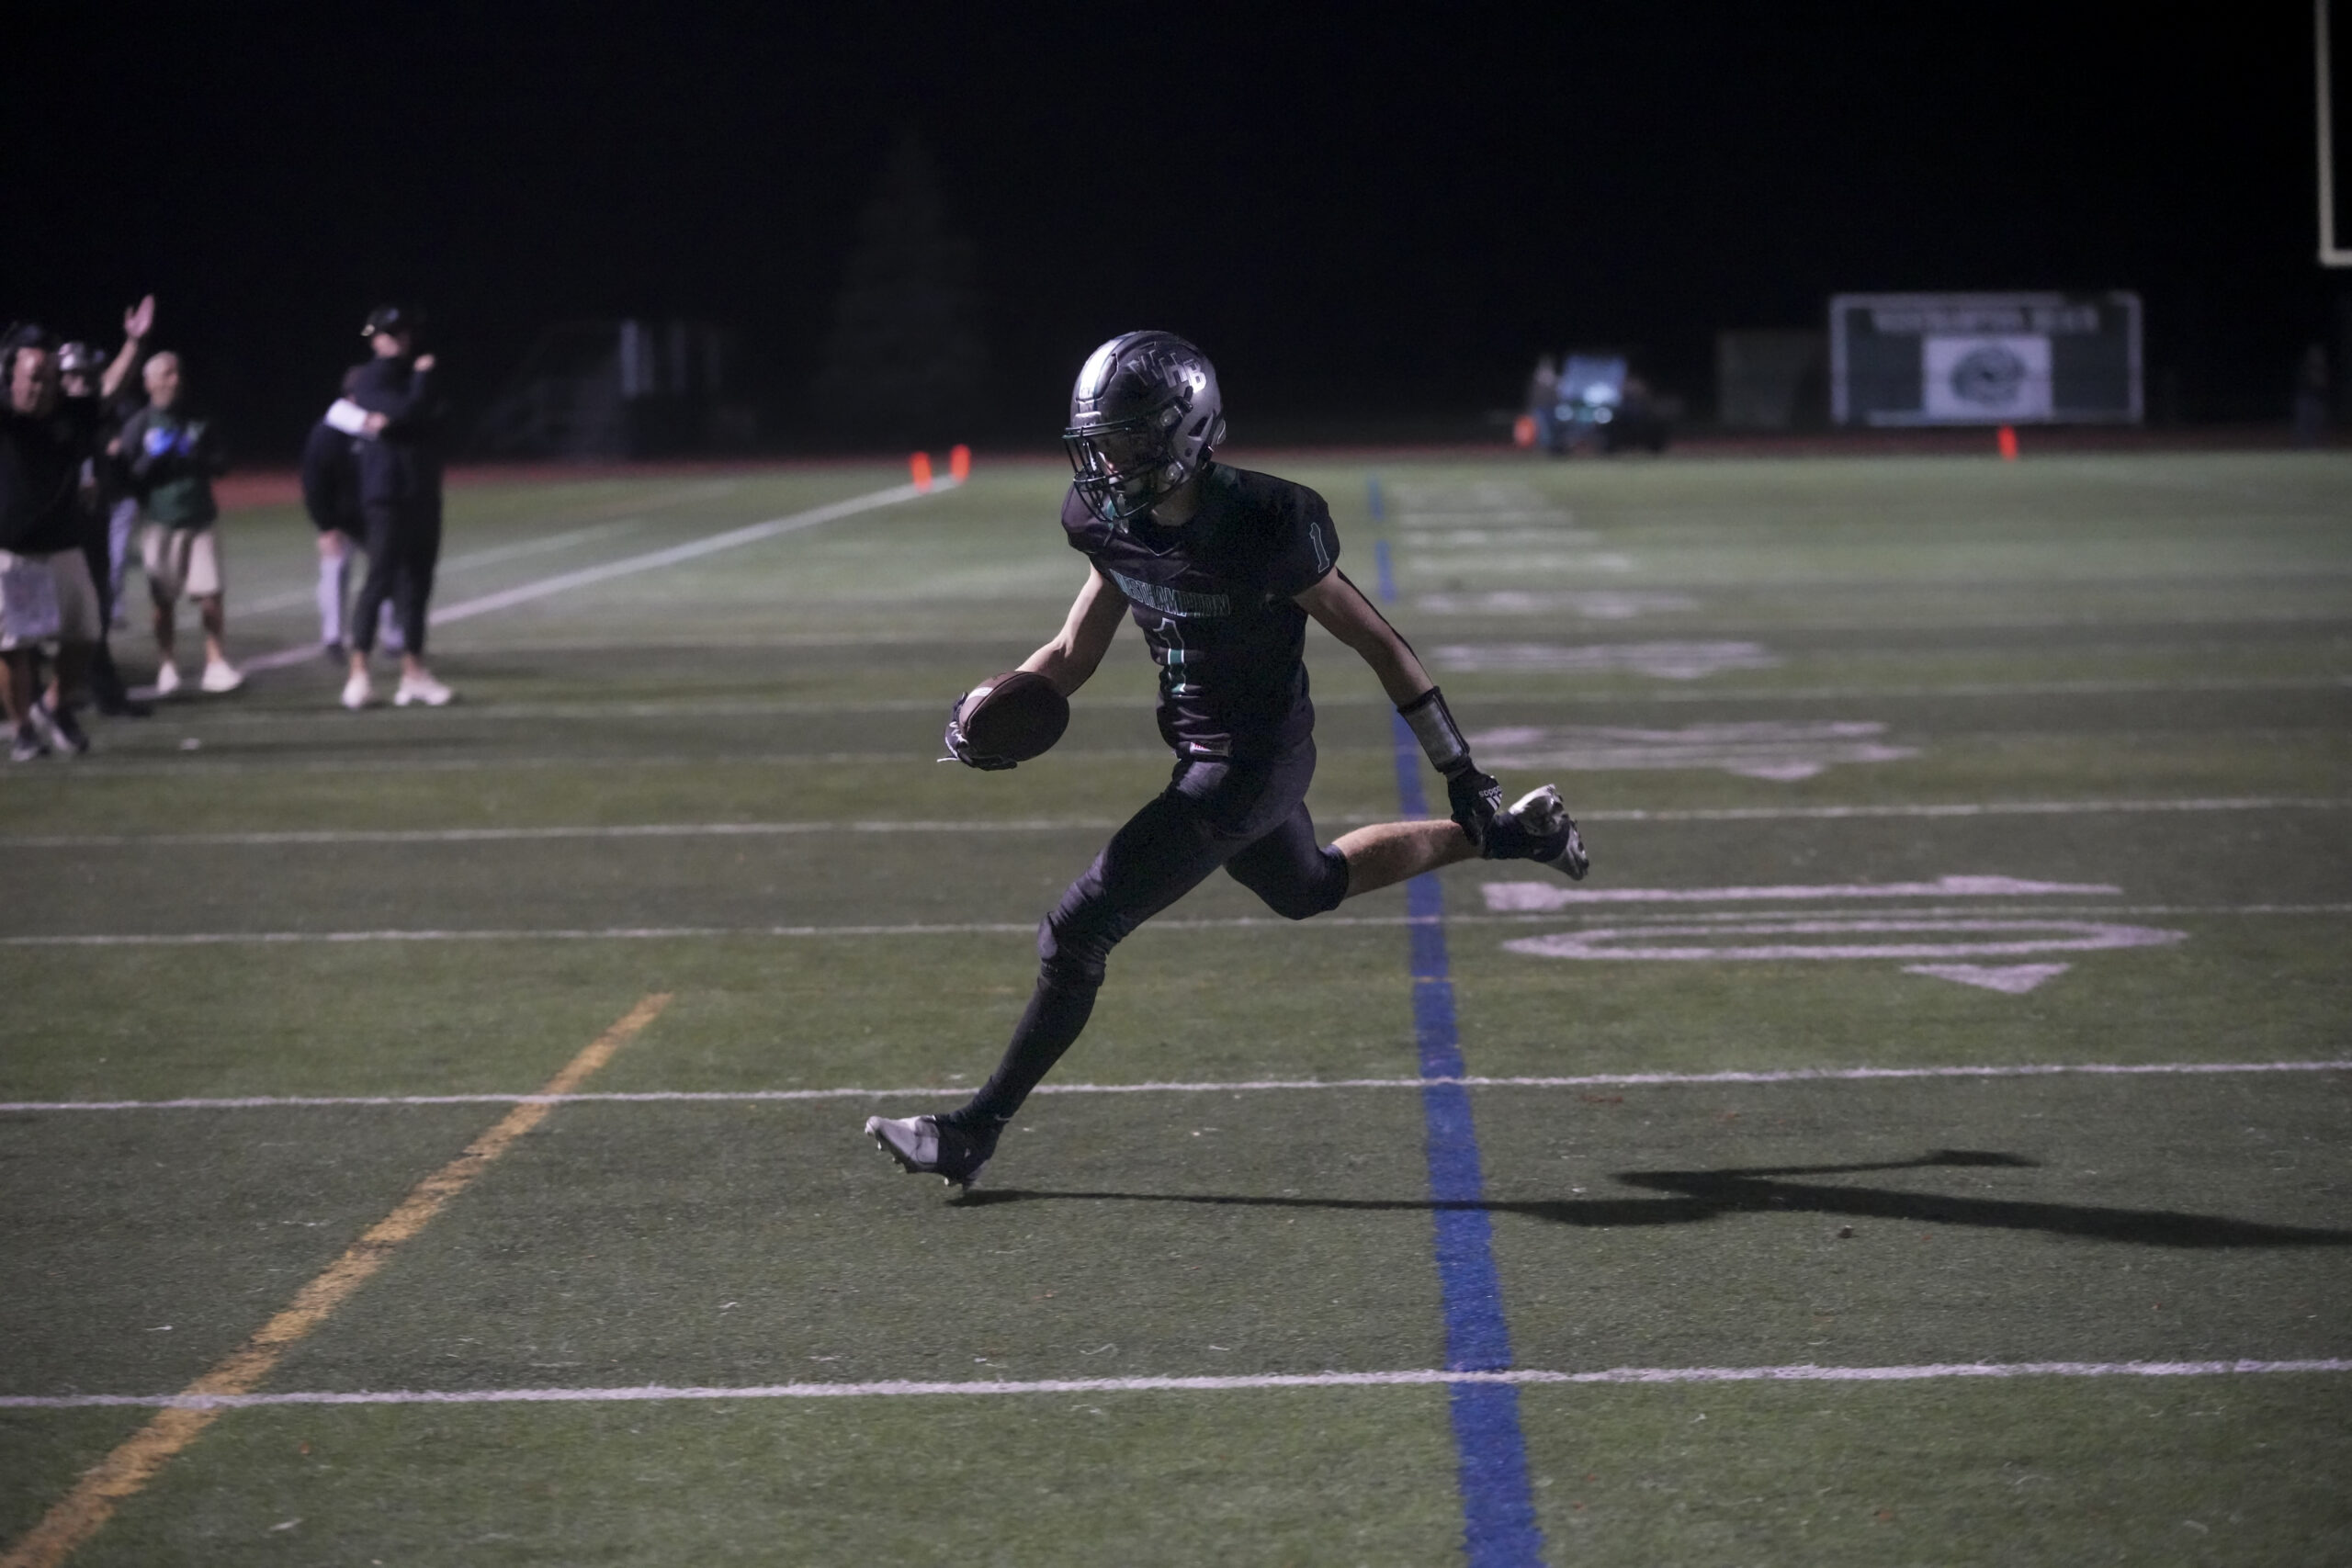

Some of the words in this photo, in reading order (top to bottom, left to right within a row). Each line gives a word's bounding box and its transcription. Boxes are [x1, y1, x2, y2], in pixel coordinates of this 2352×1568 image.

[1308, 521, 1330, 574] 1
[1152, 617, 1187, 694] 1
[1480, 874, 2190, 960] 10
